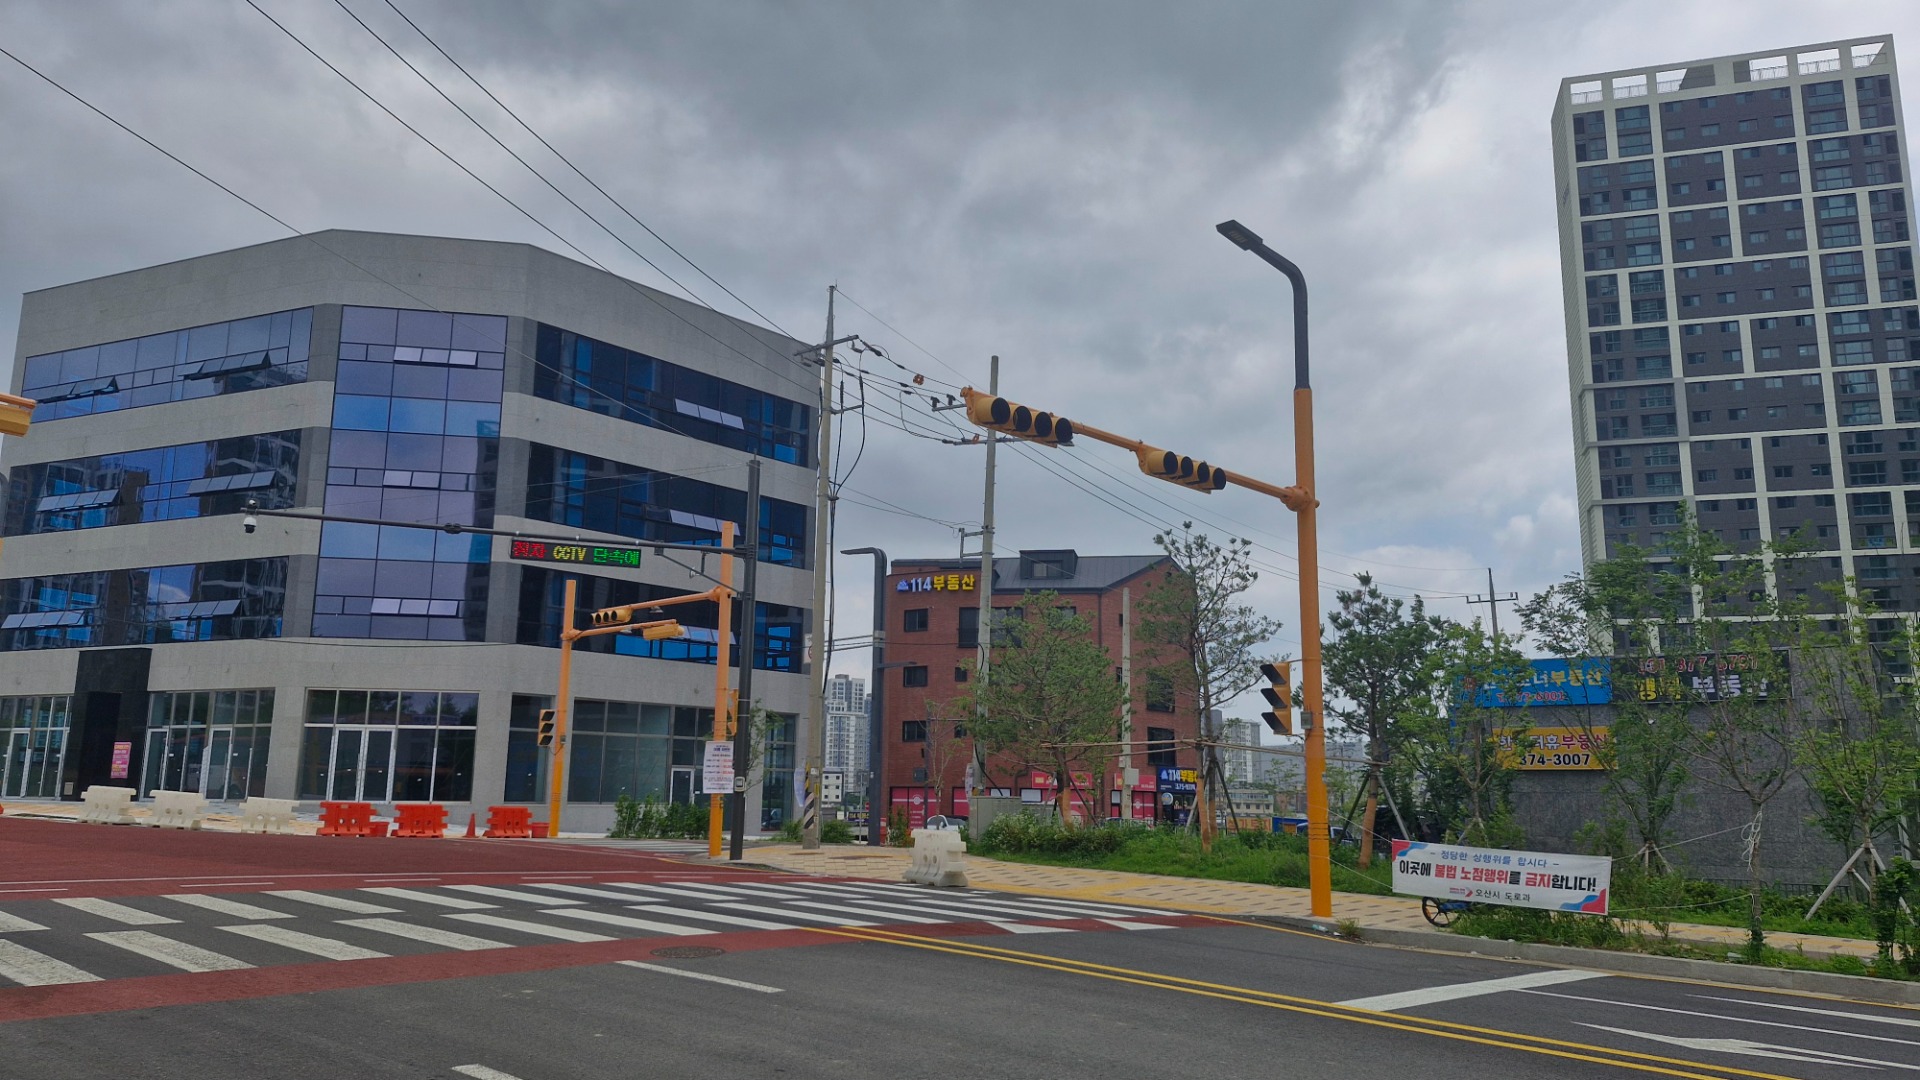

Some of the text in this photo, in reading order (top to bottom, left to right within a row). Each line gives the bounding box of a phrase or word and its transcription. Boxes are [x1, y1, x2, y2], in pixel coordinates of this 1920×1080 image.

[553, 545, 587, 561] CCTV
[1520, 753, 1590, 766] 374-3007
[1440, 850, 1547, 868] 정당한 상행위를 합시다
[1399, 860, 1597, 892] 이곳에 불법 노점행위를 금지합니다!
[1475, 889, 1500, 899] 오산시
[1505, 892, 1530, 903] 도로과
